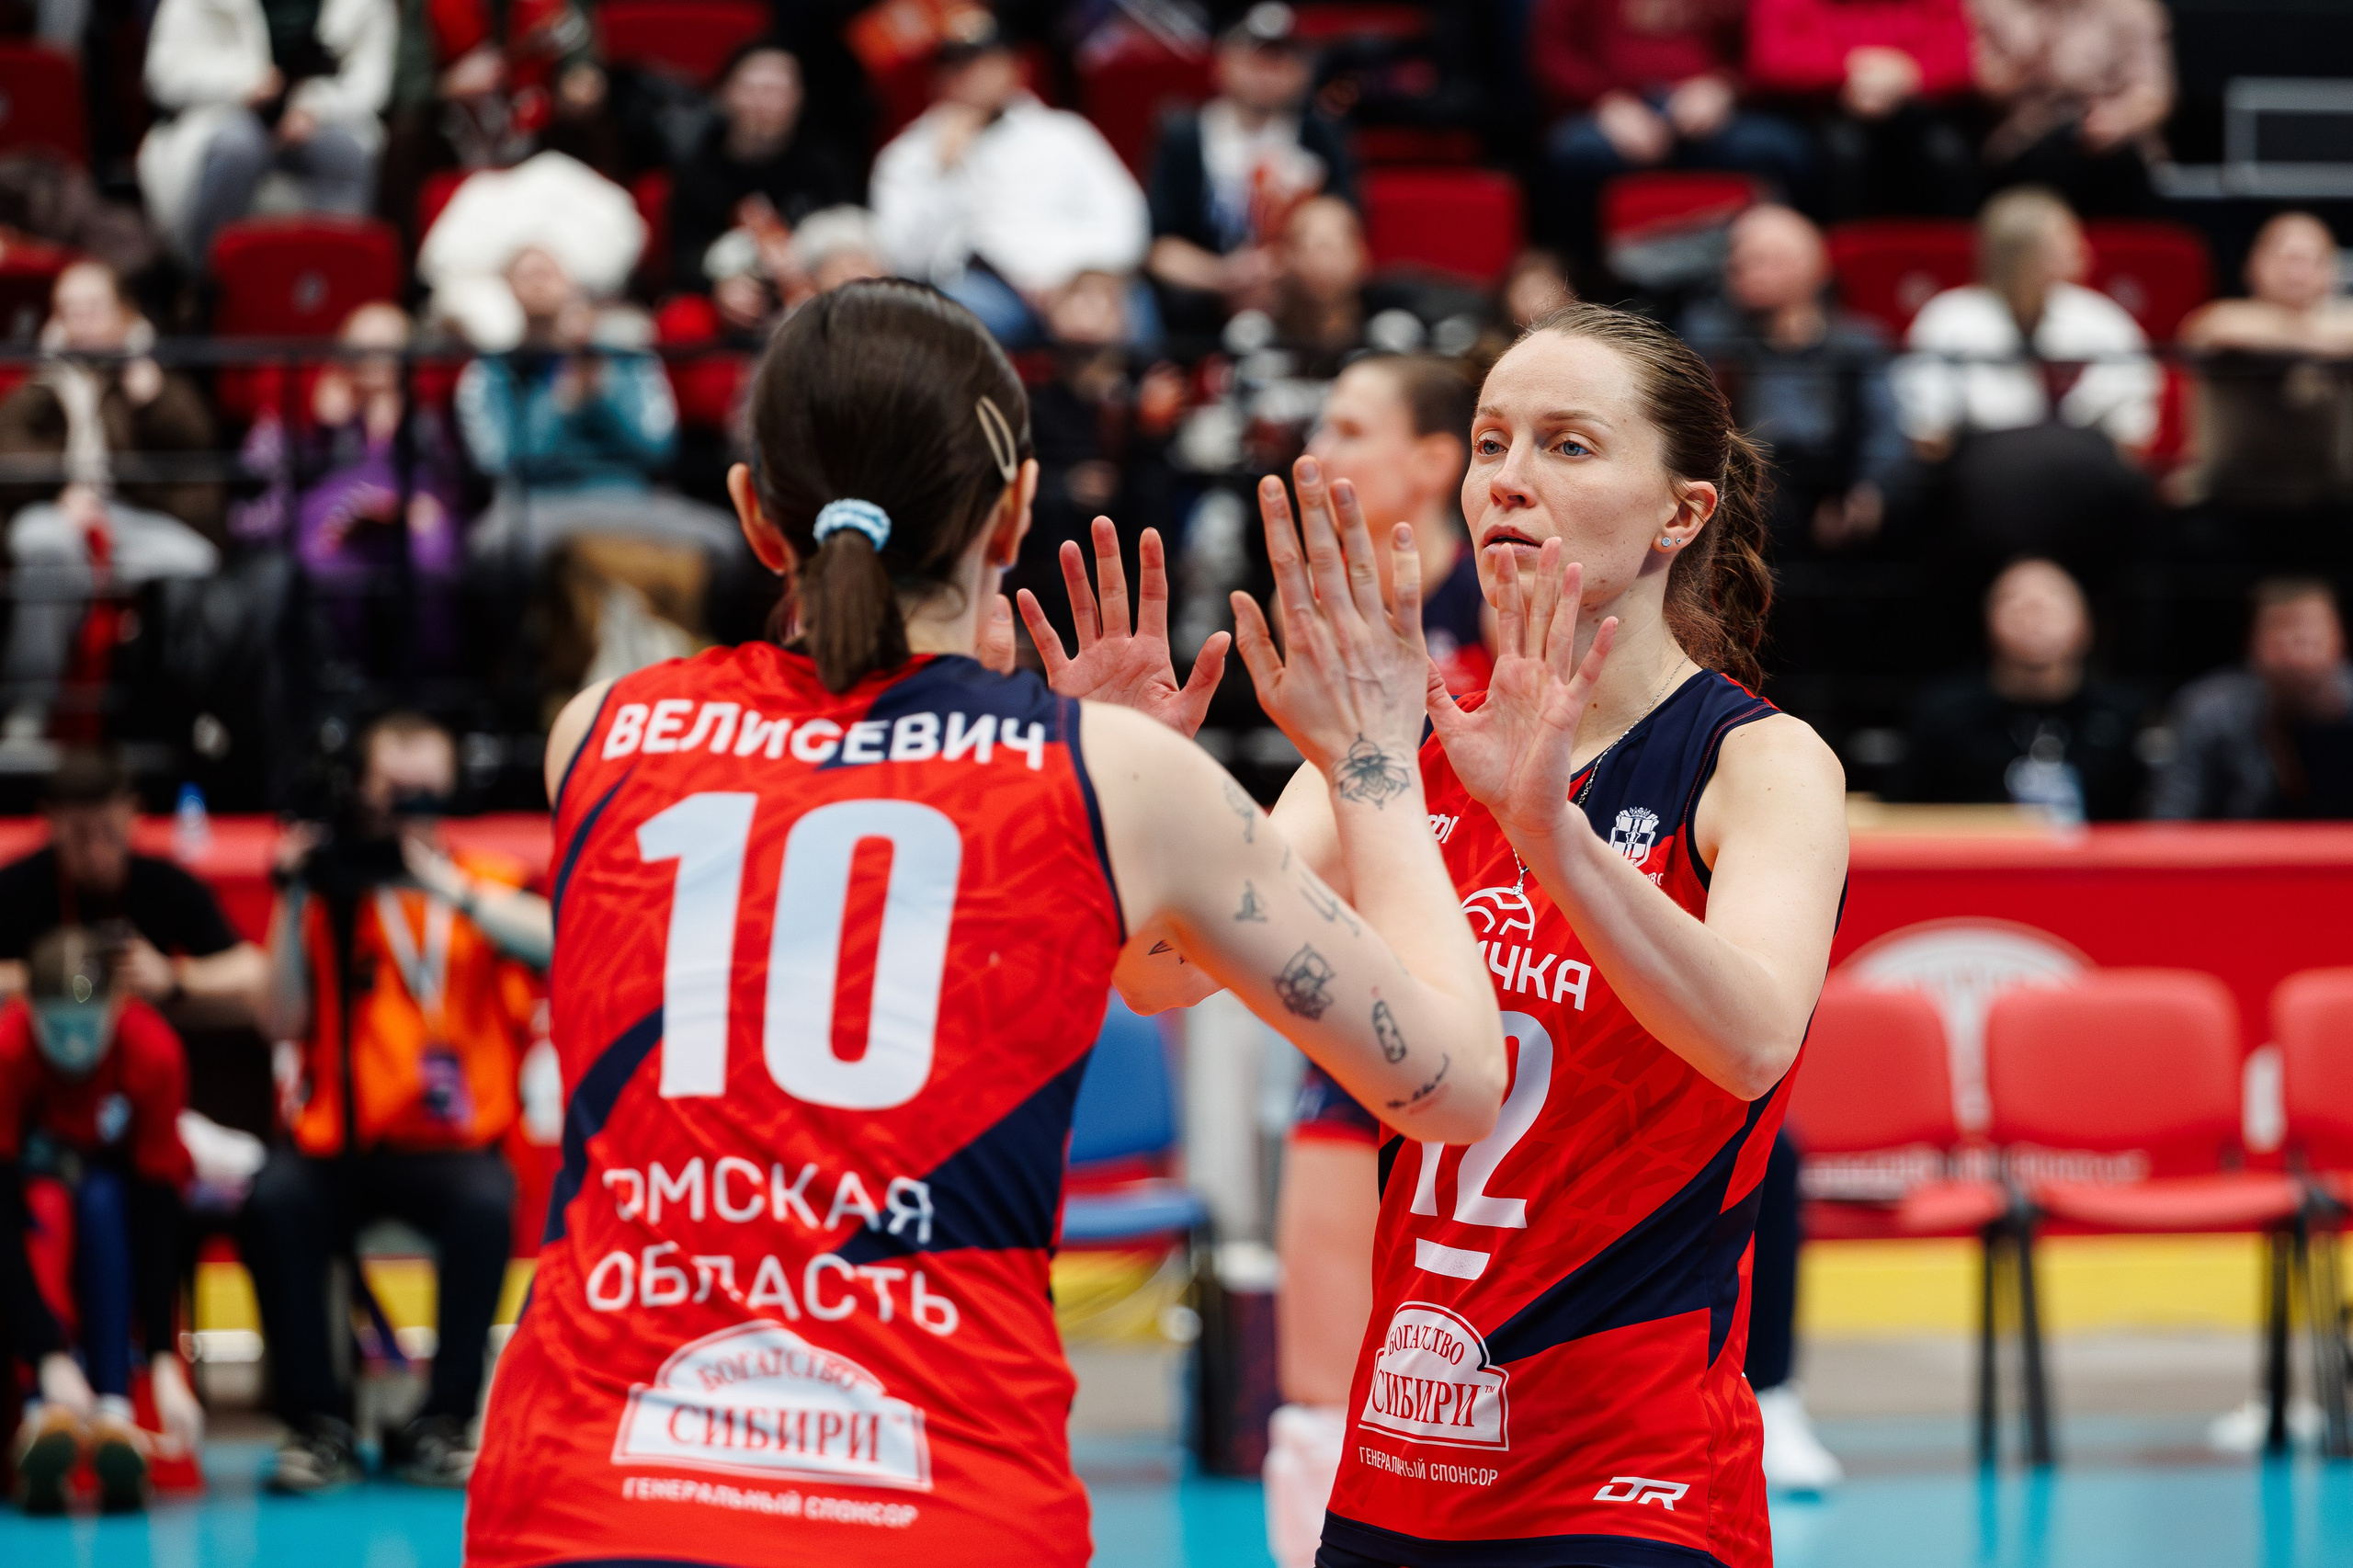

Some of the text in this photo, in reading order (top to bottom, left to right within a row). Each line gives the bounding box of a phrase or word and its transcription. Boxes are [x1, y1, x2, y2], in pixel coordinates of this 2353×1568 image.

[601, 699, 1046, 770] ВЕЛИСЕВИЧ
[636, 791, 962, 1111] 10
[602, 1156, 934, 1244] ОМСКАЯ
[585, 1240, 959, 1336] ОБЛАСТЬ
[1387, 1324, 1465, 1366] БОГАТСТВО
[1371, 1369, 1482, 1427] СИБИРИ
[666, 1403, 882, 1463] СИБИРИ
[622, 1476, 918, 1528] ГЕНЕРАЛЬНЫЙ СПОНСОР
[1430, 1462, 1499, 1487] СПОНСОР
